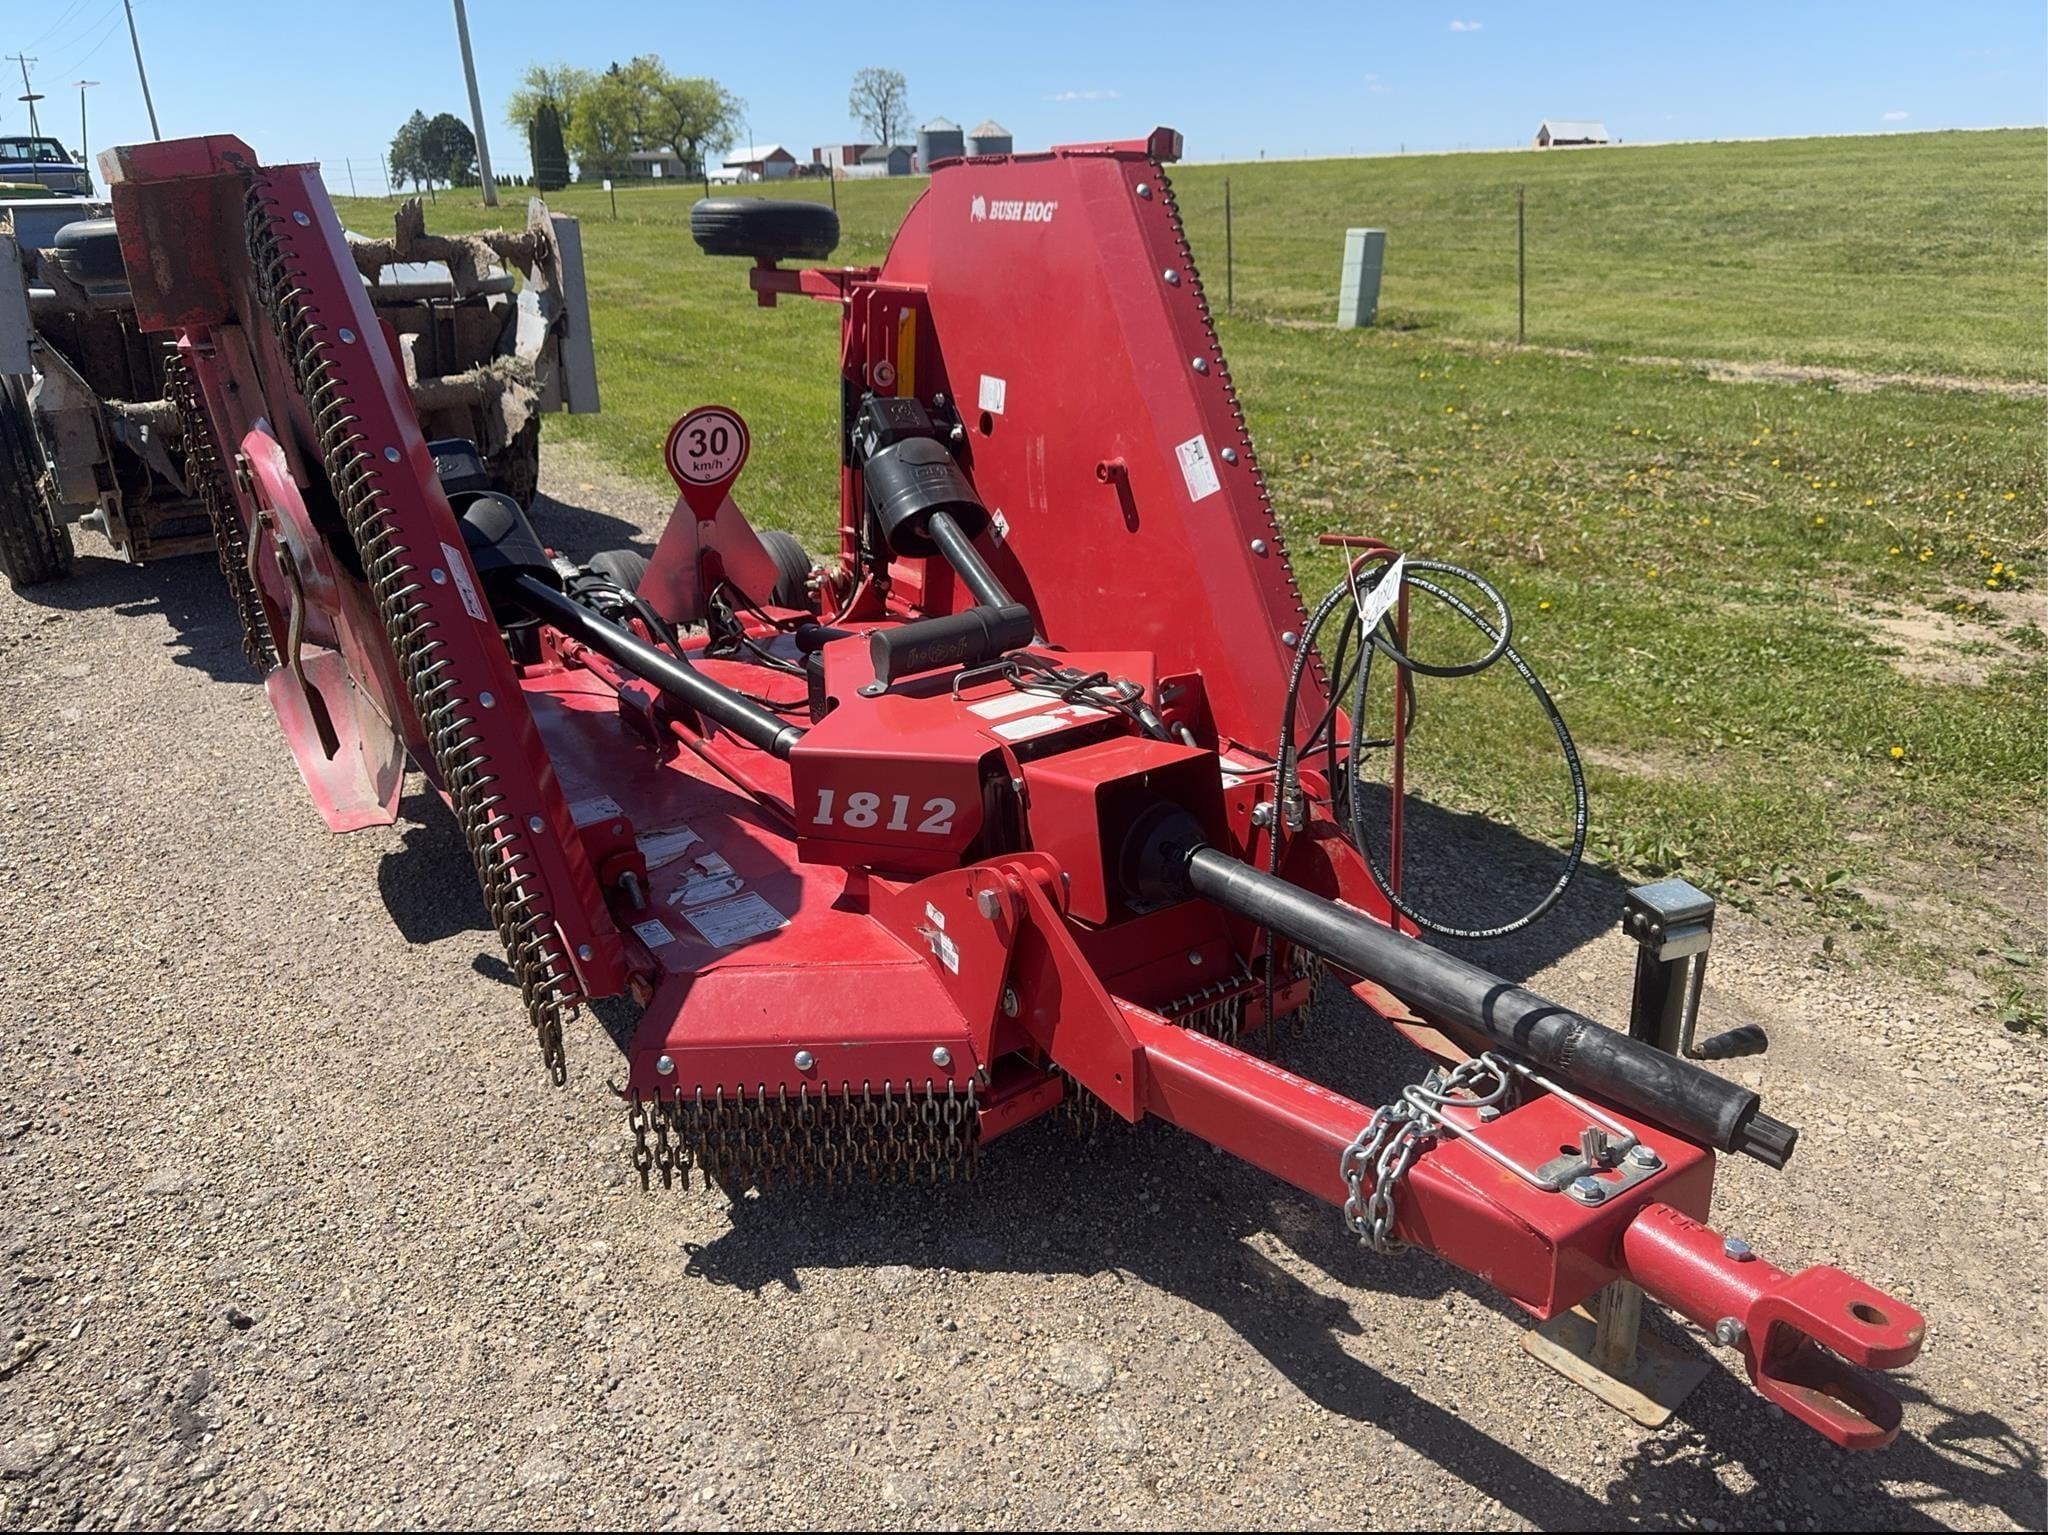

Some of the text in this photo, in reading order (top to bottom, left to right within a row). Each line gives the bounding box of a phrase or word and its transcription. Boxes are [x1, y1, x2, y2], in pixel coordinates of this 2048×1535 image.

[989, 200, 1023, 221] BUSH
[688, 427, 729, 458] 30
[692, 458, 723, 472] km/h
[812, 789, 956, 834] 1812
[1381, 881, 1395, 898] BAR
[1481, 917, 1529, 937] HANSA-FLEX
